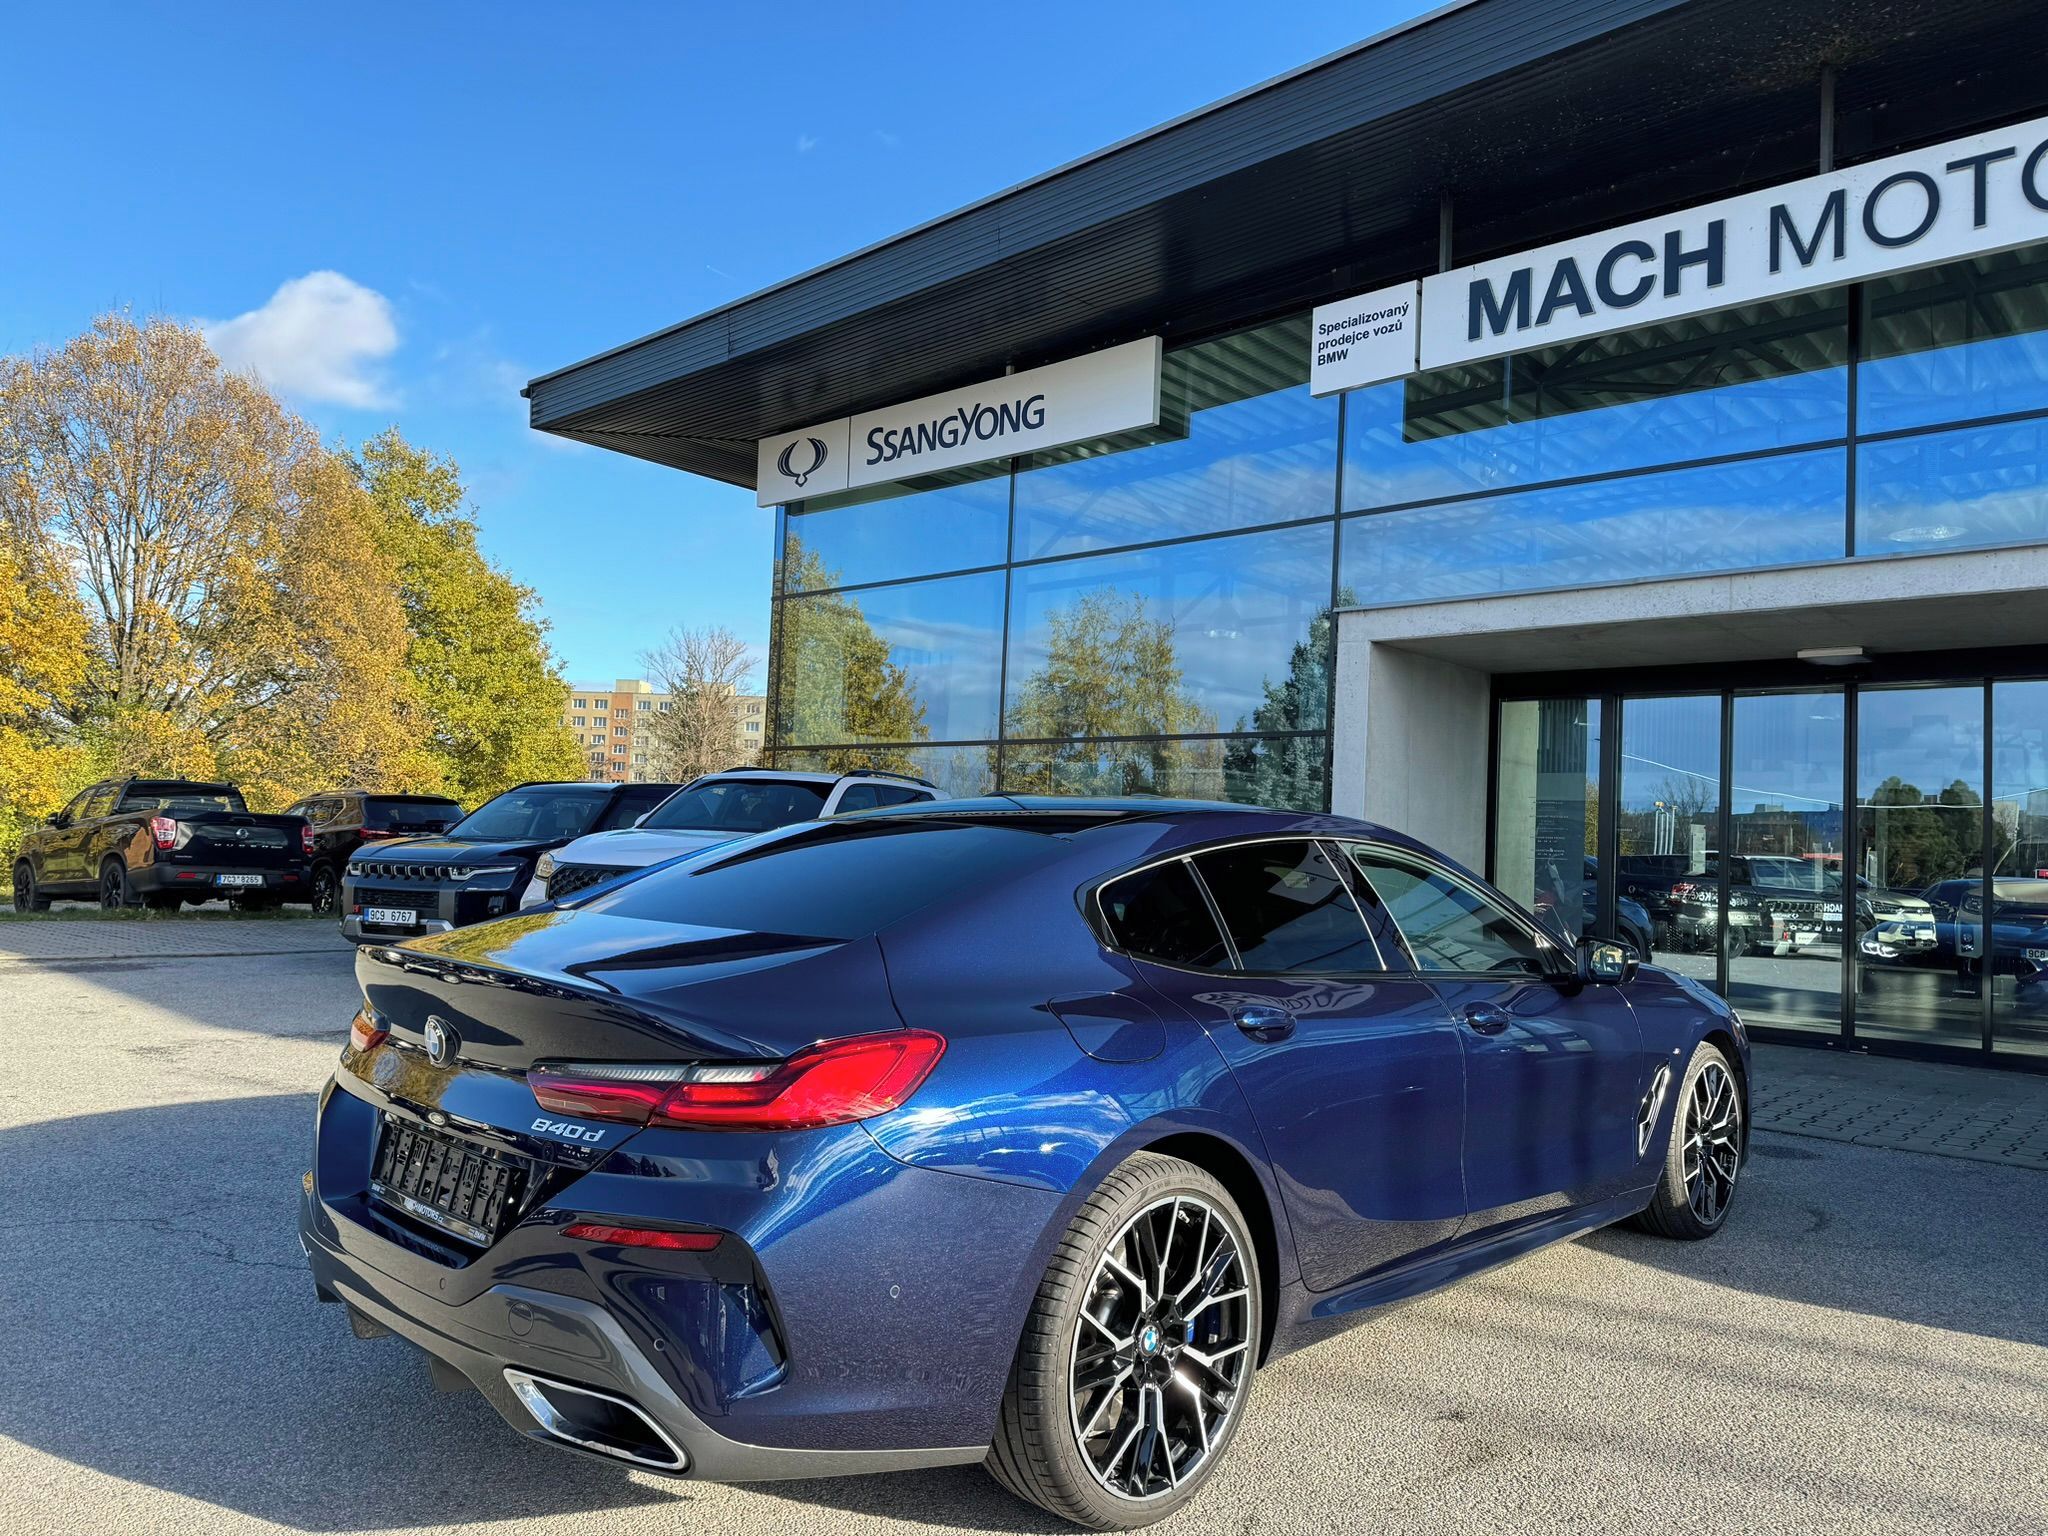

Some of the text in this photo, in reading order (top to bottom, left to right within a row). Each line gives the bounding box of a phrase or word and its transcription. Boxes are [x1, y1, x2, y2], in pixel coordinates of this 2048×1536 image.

[1467, 218, 1726, 342] MACH
[1318, 302, 1409, 336] Specializovaný
[1318, 330, 1370, 354] prodejce
[1317, 348, 1349, 366] BMW
[370, 909, 412, 922] 9C9 6767
